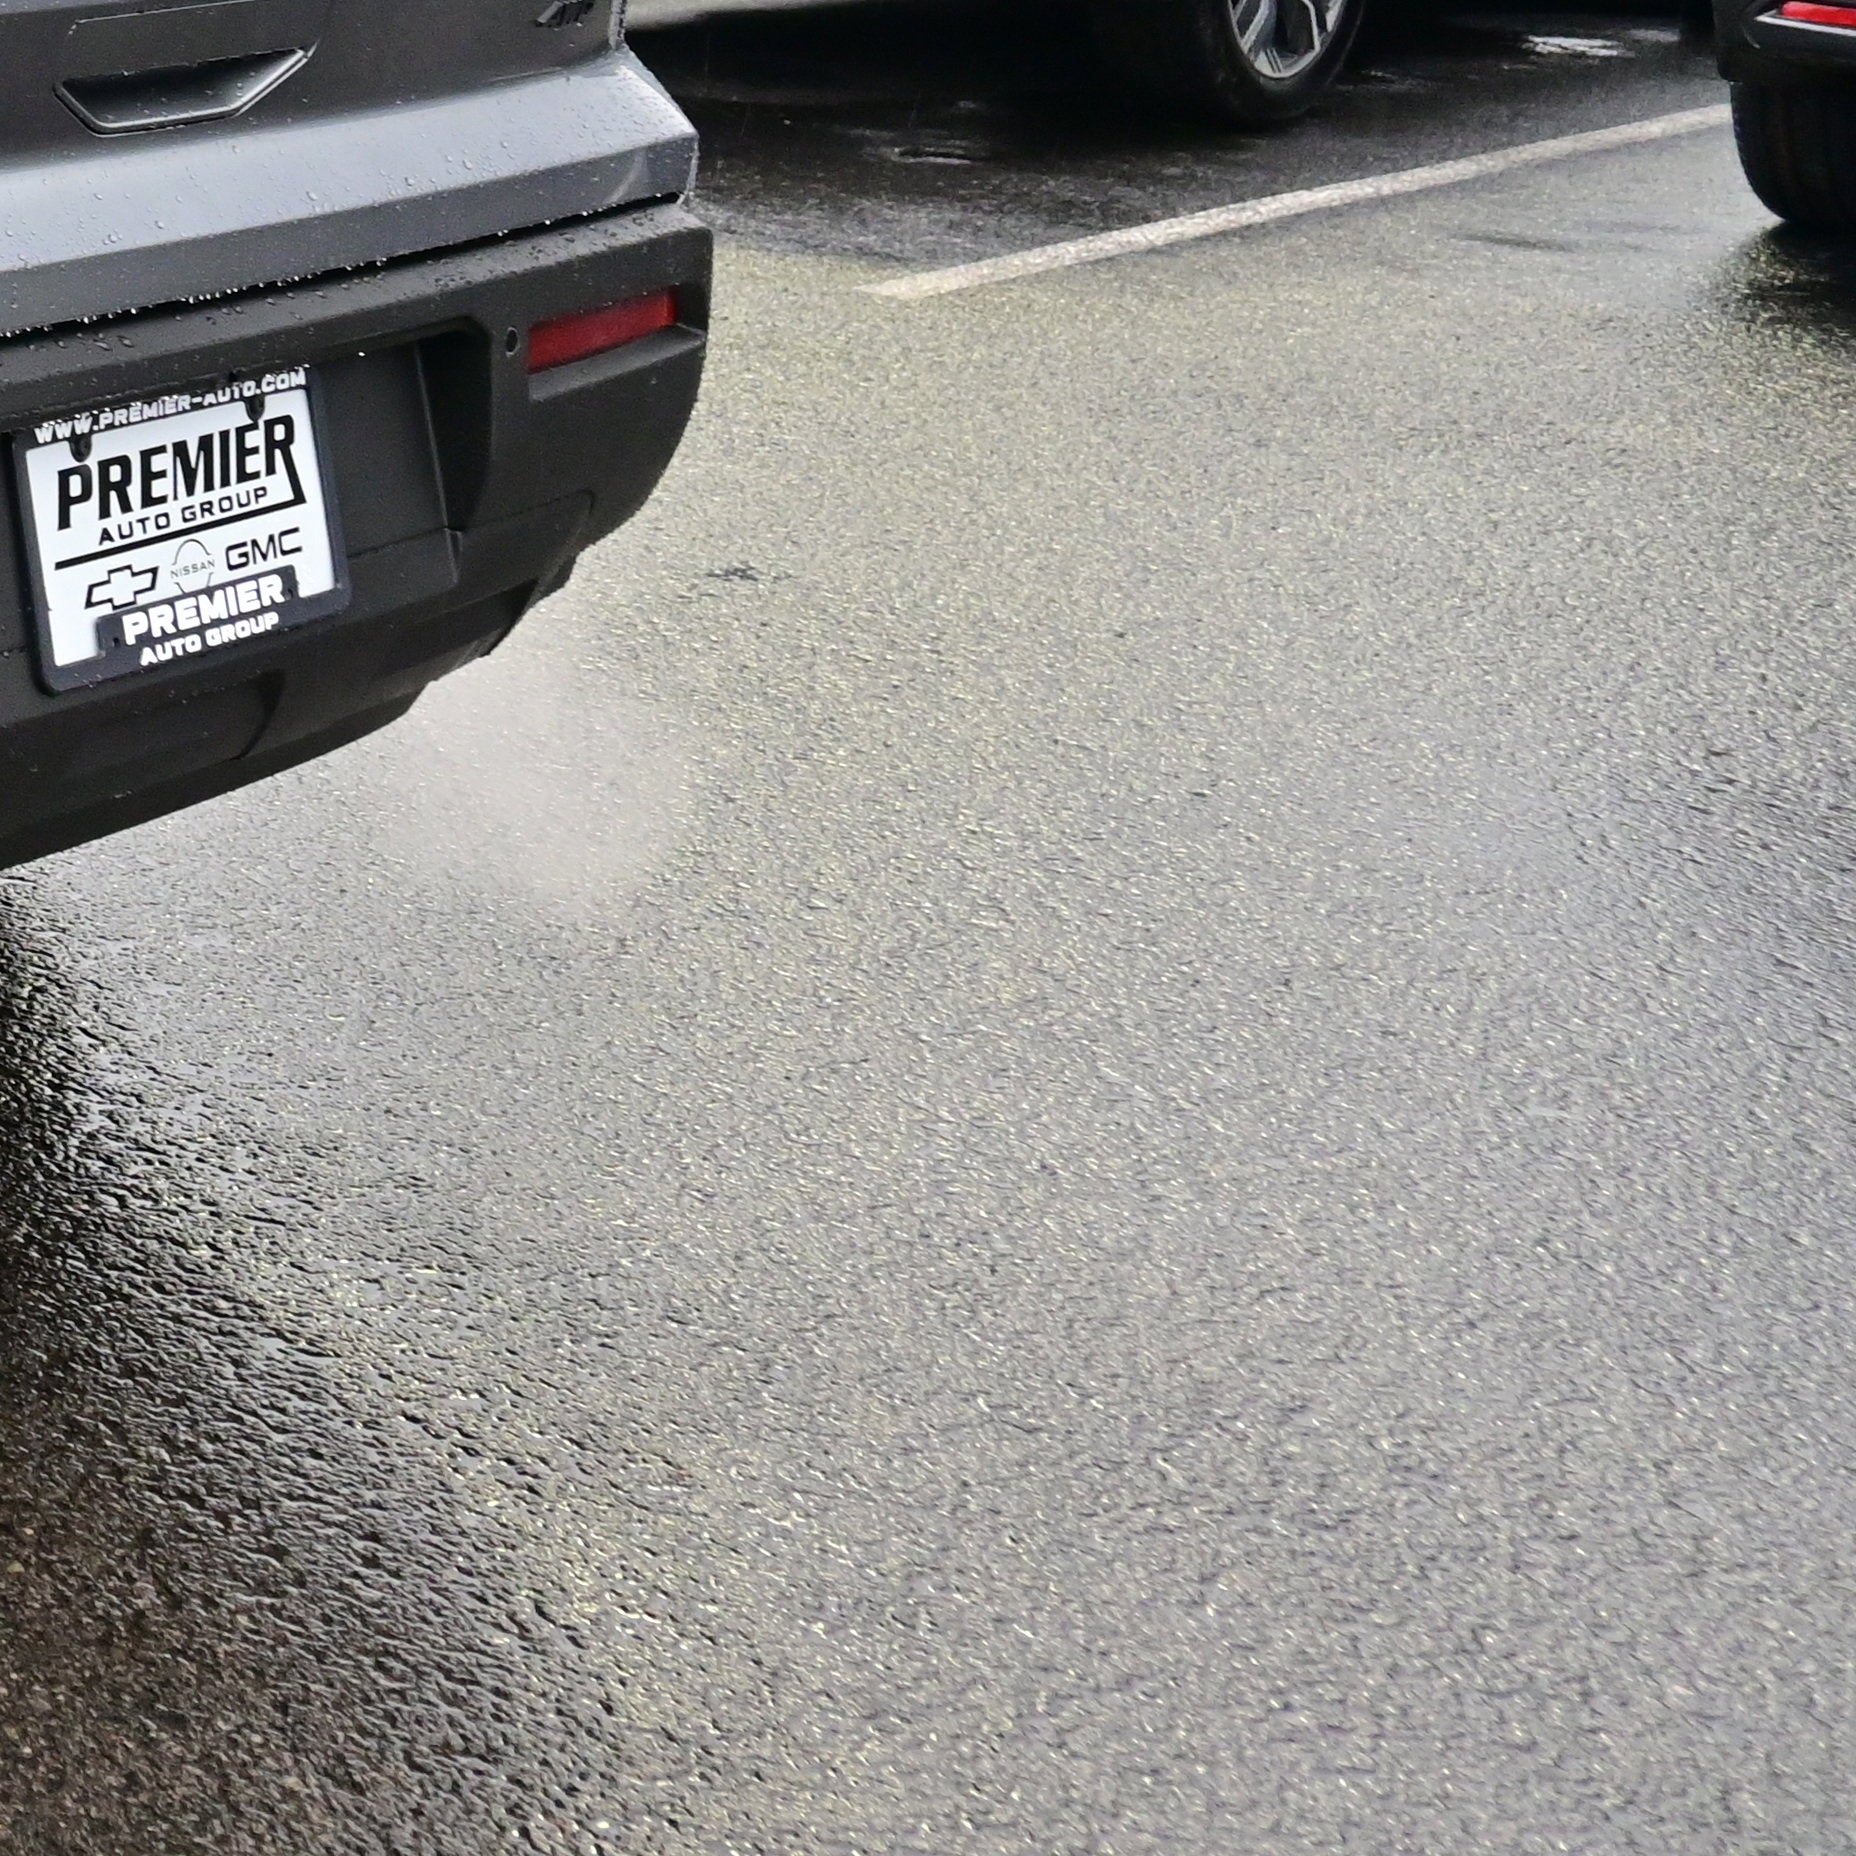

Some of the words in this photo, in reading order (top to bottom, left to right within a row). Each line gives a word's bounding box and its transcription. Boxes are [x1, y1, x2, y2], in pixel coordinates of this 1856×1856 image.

[34, 369, 307, 444] WWW.PREMIER-AUTO.COM
[57, 414, 306, 532] PREMIER
[98, 512, 171, 546] AUTO
[181, 486, 268, 524] GROUP
[170, 559, 216, 579] NISSAN
[225, 527, 303, 571] GMC
[122, 574, 286, 646] PREMIER
[140, 634, 203, 667] AUTO
[205, 612, 280, 647] GROUP
